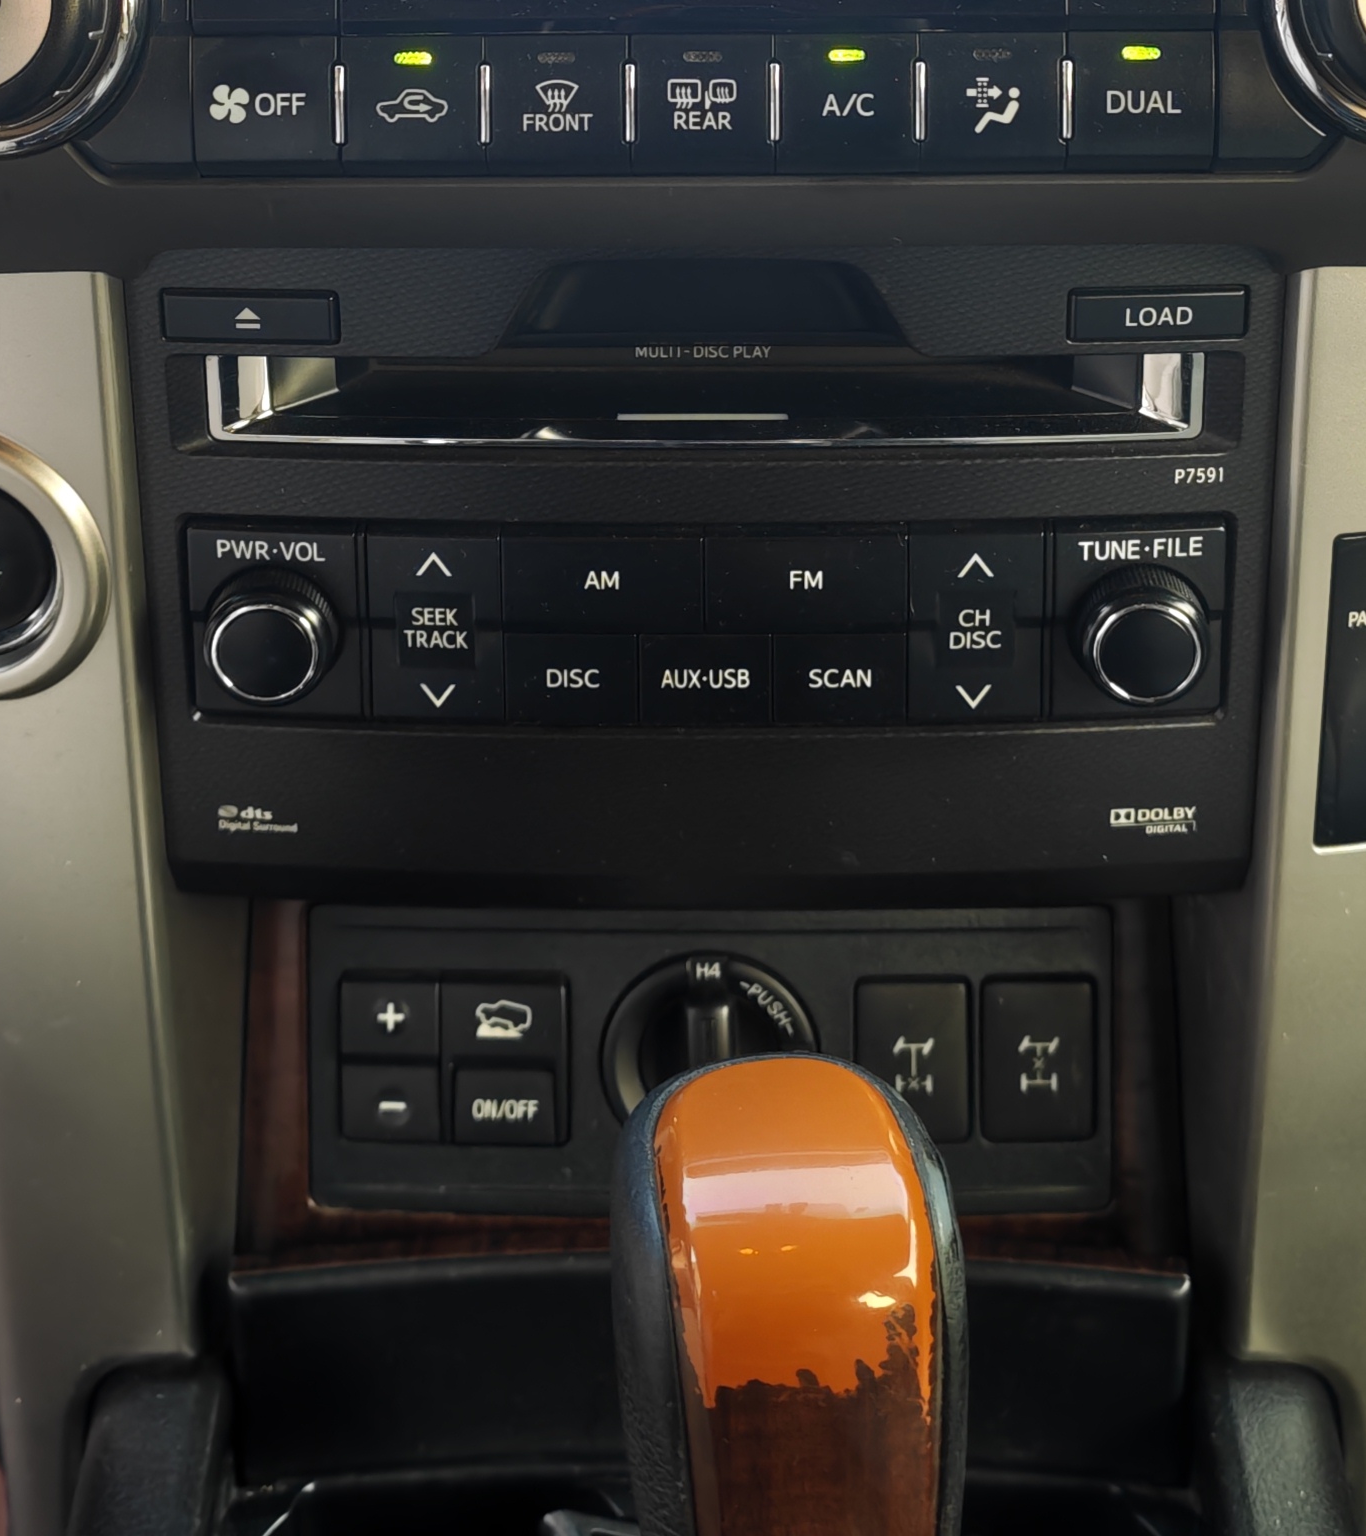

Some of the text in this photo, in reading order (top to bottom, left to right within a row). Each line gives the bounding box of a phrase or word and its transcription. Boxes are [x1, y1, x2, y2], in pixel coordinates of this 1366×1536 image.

[254, 92, 307, 117] OFF
[822, 93, 876, 118] A/C
[1106, 89, 1183, 115] DUAL
[522, 113, 594, 133] FRONT
[673, 111, 733, 132] REAR
[1124, 306, 1194, 328] LOAD
[635, 345, 772, 359] MULTI-DISC PLAY
[1174, 467, 1225, 485] P7591
[584, 570, 621, 591] AM
[789, 570, 824, 591] FM
[411, 607, 459, 627] SEEK
[958, 609, 991, 627] CH
[404, 629, 469, 650] TRACK
[949, 630, 1002, 650] DISC
[546, 668, 600, 690] DISC
[808, 668, 873, 689] SCAN
[240, 806, 273, 820] dts
[1137, 806, 1196, 821] DOLBY
[219, 820, 298, 833] Digital Surround
[1145, 824, 1188, 834] DIGITAL
[695, 960, 723, 981] H4
[471, 1097, 539, 1122] ON/OFF
